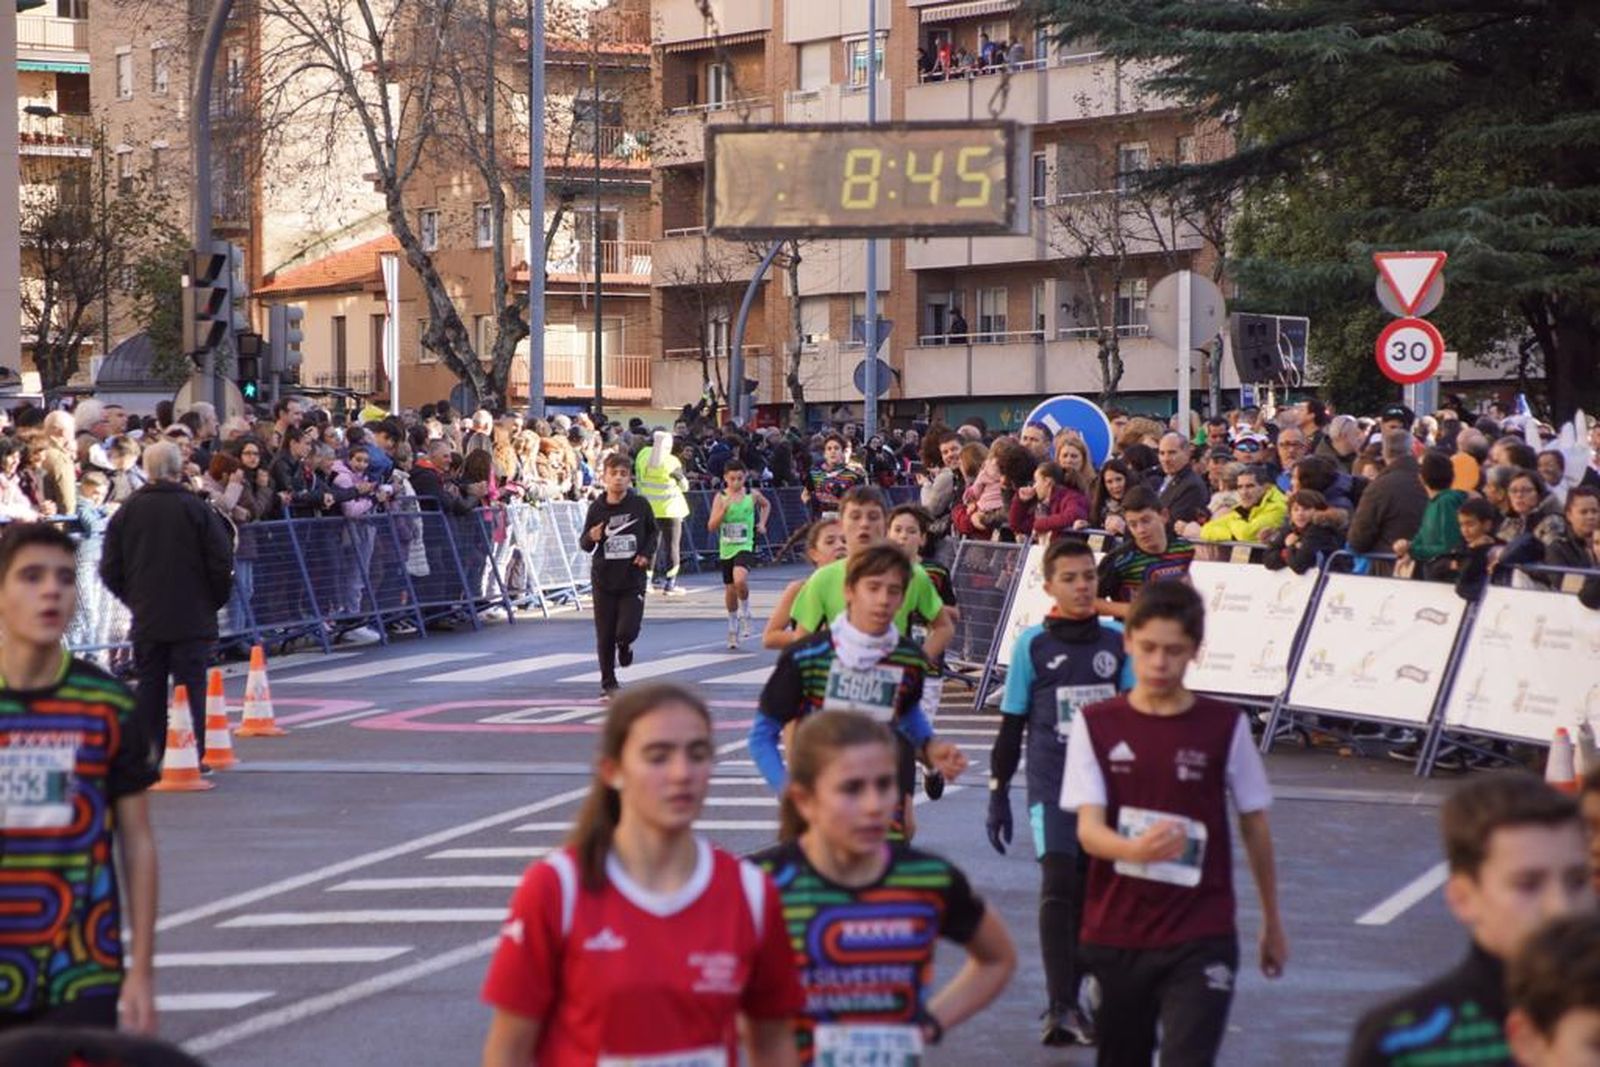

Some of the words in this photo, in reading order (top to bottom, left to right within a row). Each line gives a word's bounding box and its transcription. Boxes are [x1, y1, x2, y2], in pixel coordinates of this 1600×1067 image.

[841, 147, 992, 209] 8:45
[1392, 341, 1427, 362] 30
[837, 673, 883, 704] 5604
